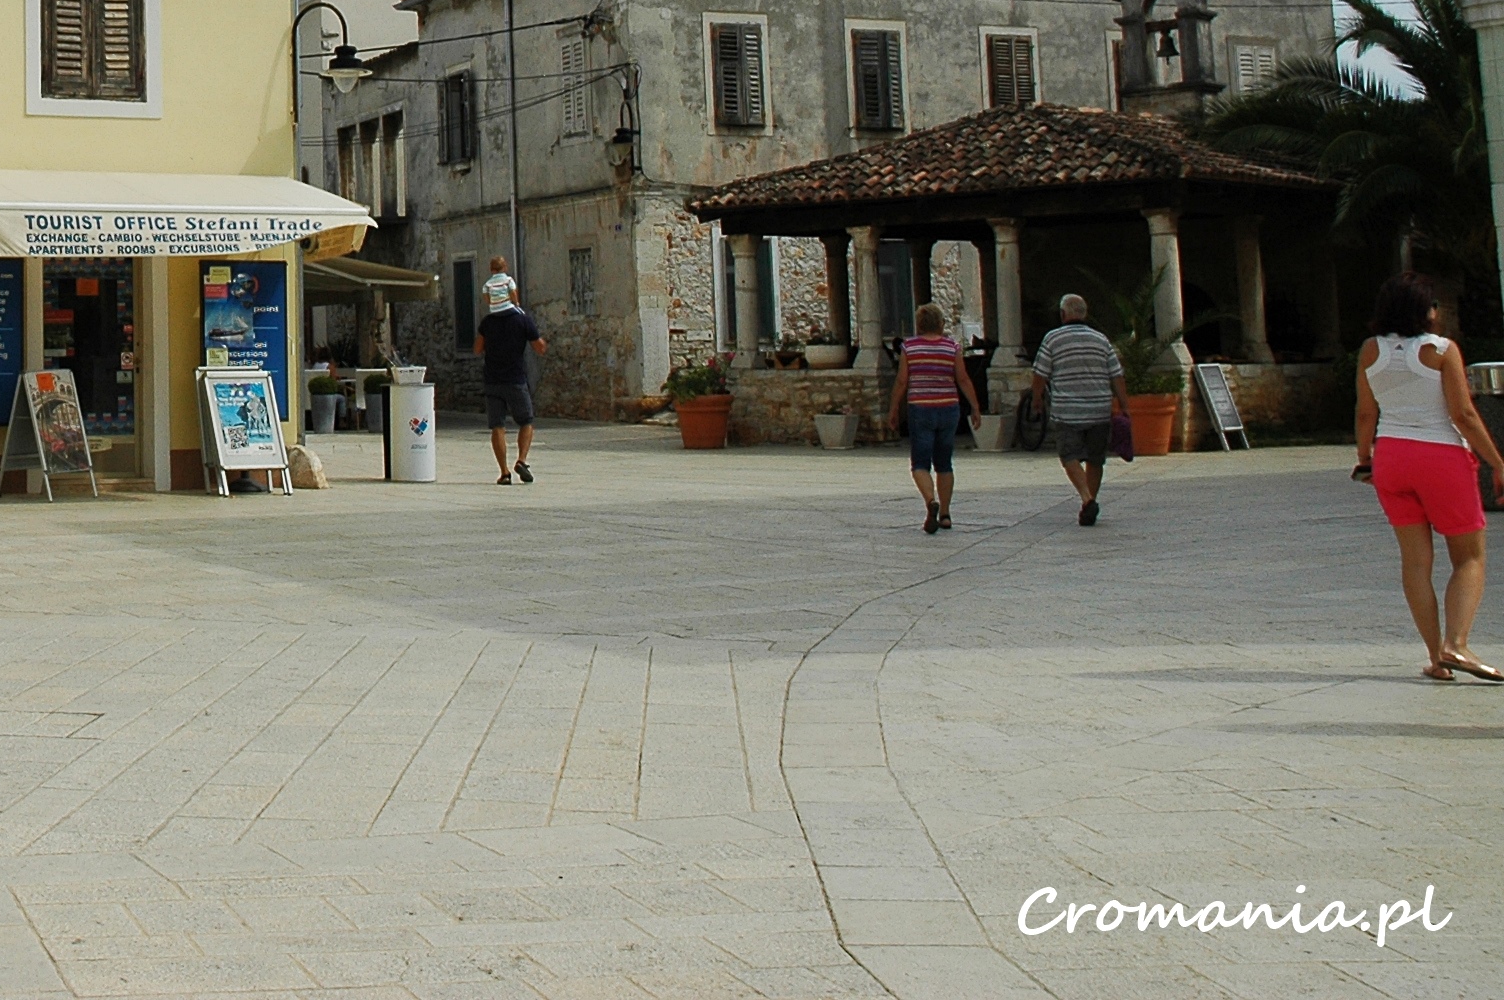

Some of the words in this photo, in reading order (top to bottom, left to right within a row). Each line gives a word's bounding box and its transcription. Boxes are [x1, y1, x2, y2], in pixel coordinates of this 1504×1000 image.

[24, 215, 103, 230] TOURIST
[114, 216, 177, 230] OFFICE
[185, 216, 259, 230] Stefani
[266, 217, 323, 231] Trade
[26, 233, 89, 243] EXCHANGE
[98, 233, 143, 243] CAMBIO
[152, 232, 241, 242] WECHSELSTUBE
[28, 245, 104, 255] APARTMENTS
[117, 245, 156, 255] ROOMS
[169, 244, 240, 254] EXCURSIONS
[229, 349, 268, 357] xcursions
